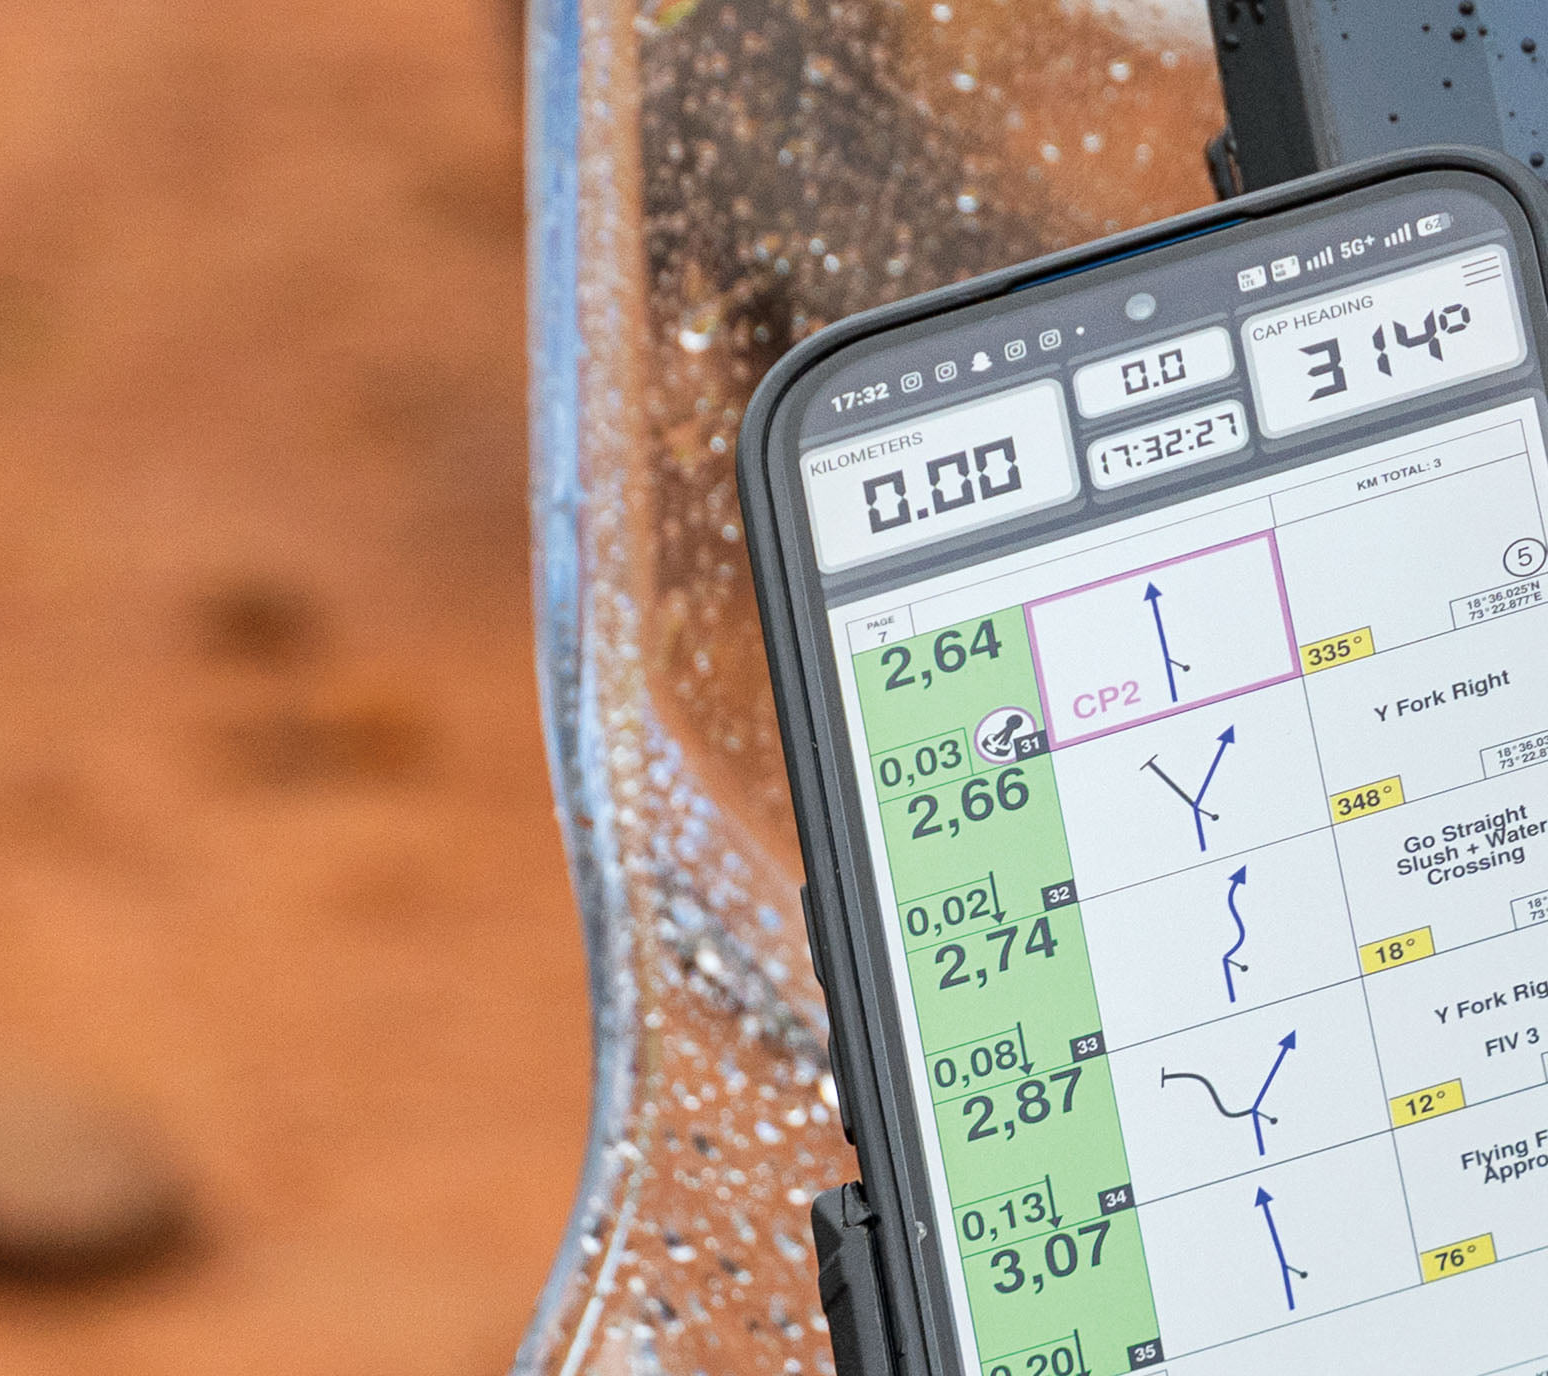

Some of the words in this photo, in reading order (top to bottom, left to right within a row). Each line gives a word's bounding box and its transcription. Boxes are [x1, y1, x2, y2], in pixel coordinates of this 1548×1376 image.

[1340, 233, 1376, 259] 5G+
[1252, 318, 1290, 343] CAP
[1293, 294, 1374, 332] HEADING
[1121, 348, 1187, 395] 0.0
[830, 382, 890, 413] 17:32
[810, 431, 924, 477] KILOMETERS
[1100, 412, 1238, 475] 17:32:27
[863, 436, 1022, 534] 0.00
[1356, 476, 1379, 492] KM
[1382, 462, 1432, 485] TOTAL:
[1433, 458, 1443, 470] 3
[1517, 545, 1533, 567] 5
[866, 614, 895, 631] PAGE
[877, 631, 888, 644] 7
[880, 619, 1003, 691] 2,64
[1073, 680, 1142, 720] CP2
[1373, 704, 1389, 724] Y
[1396, 688, 1447, 717] Fork
[1452, 669, 1511, 702] Right
[879, 739, 962, 787] 0,03
[1020, 735, 1041, 752] 31
[907, 767, 1030, 840] 2,66
[1397, 845, 1459, 876] Slush
[1466, 842, 1480, 857] +
[1485, 818, 1548, 848] Water
[1404, 835, 1436, 854] Go
[1442, 804, 1528, 843] Straight
[1427, 846, 1526, 886] Crossing
[906, 888, 990, 937] 0,02
[1048, 886, 1071, 903] 32
[934, 916, 1058, 990] 2,74
[1434, 1006, 1450, 1025] Y
[1456, 992, 1508, 1019] Fork
[933, 1039, 1018, 1089] 0,08
[1076, 1037, 1099, 1055] 33
[1484, 1032, 1520, 1057] FIV
[1526, 1027, 1540, 1044] 3
[962, 1066, 1083, 1142] 2,87
[1461, 1137, 1529, 1171] Flying
[962, 1192, 1047, 1242] 0,13
[1105, 1190, 1128, 1208] 34
[990, 1220, 1112, 1295] 3,07
[1133, 1345, 1158, 1363] 35
